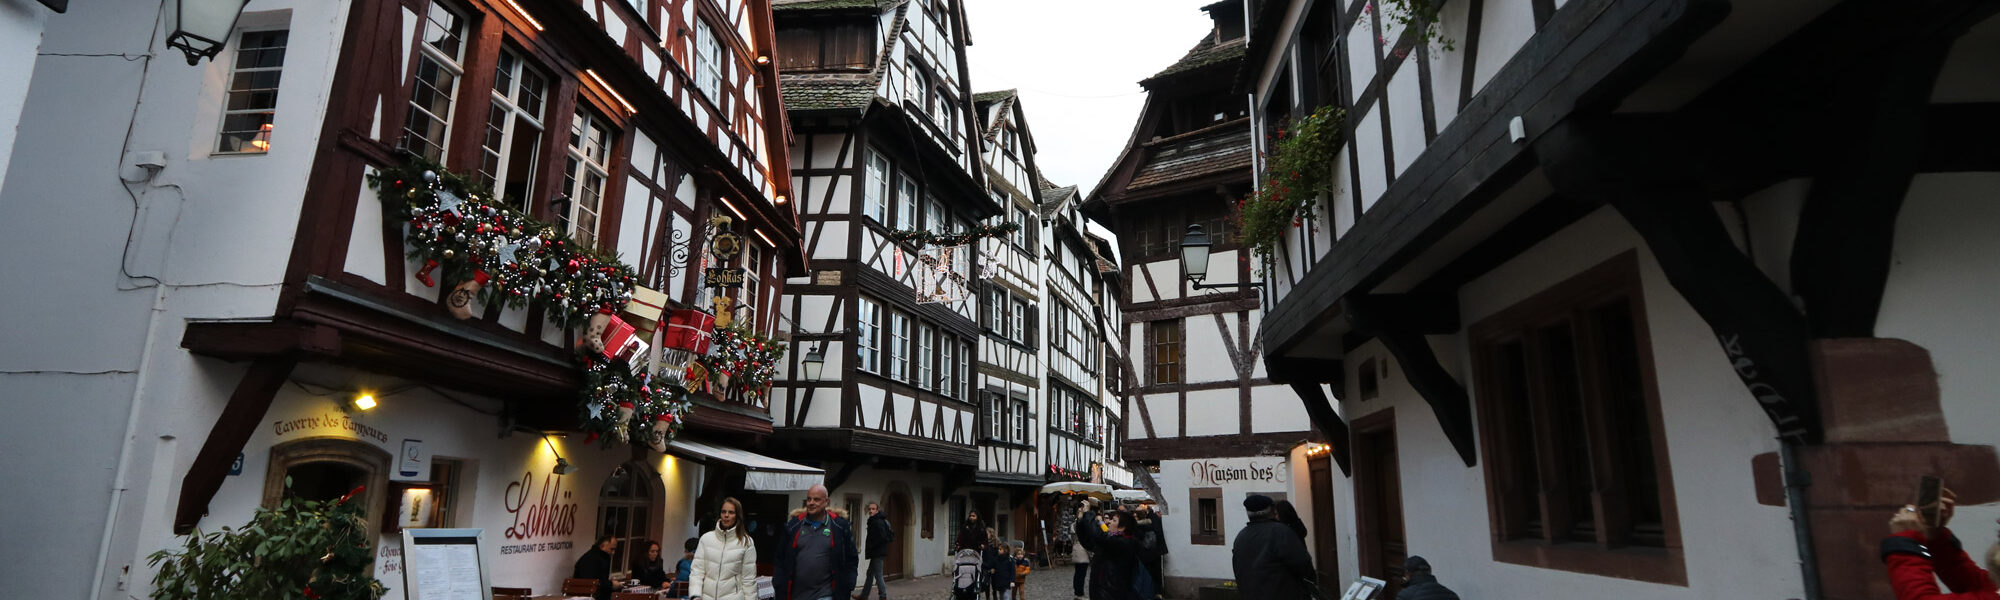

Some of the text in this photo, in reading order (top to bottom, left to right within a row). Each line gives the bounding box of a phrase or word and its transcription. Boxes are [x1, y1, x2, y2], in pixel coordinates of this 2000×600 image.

[322, 414, 339, 428] des
[1191, 460, 1248, 485] Maison
[1249, 461, 1274, 483] des
[505, 471, 578, 540] Lohkäs
[500, 541, 573, 555] RESTAURANT DE TRADITION
